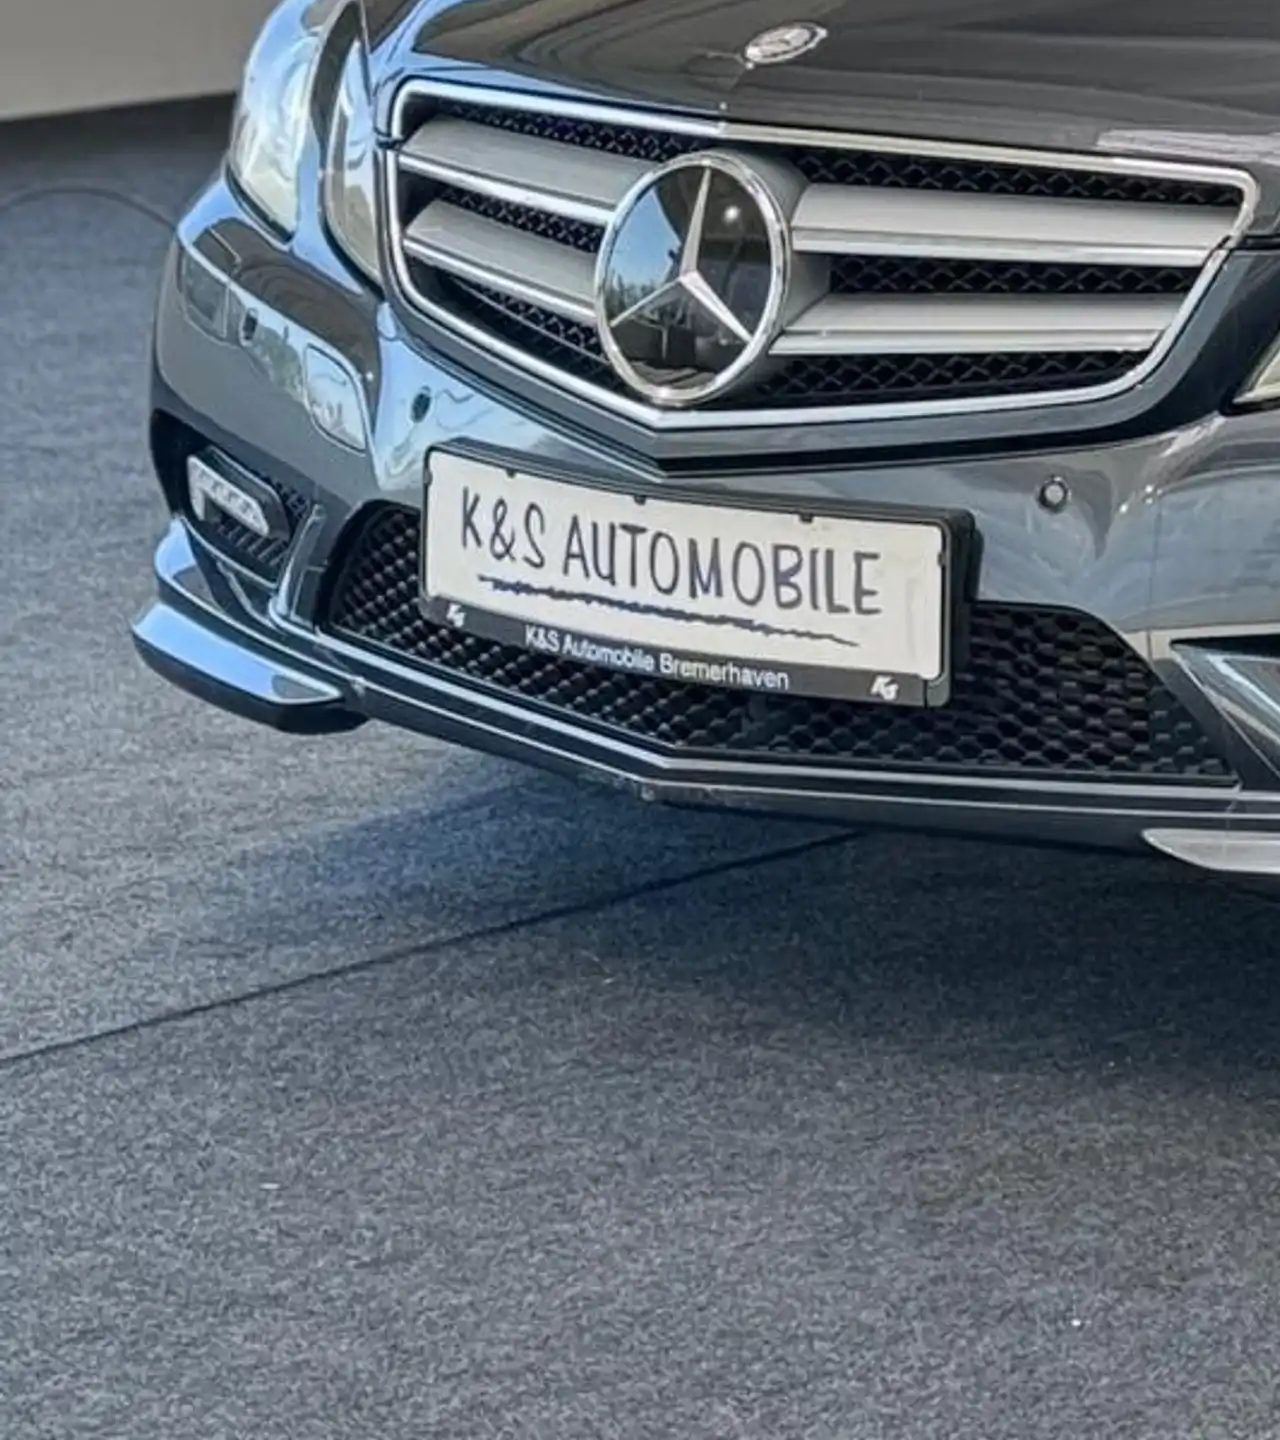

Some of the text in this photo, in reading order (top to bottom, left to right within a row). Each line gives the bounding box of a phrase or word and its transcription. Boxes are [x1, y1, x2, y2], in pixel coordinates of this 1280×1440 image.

[463, 487, 882, 615] K&S AUTOMOBILE
[525, 625, 789, 690] K&S Automobile Bremerhaven
